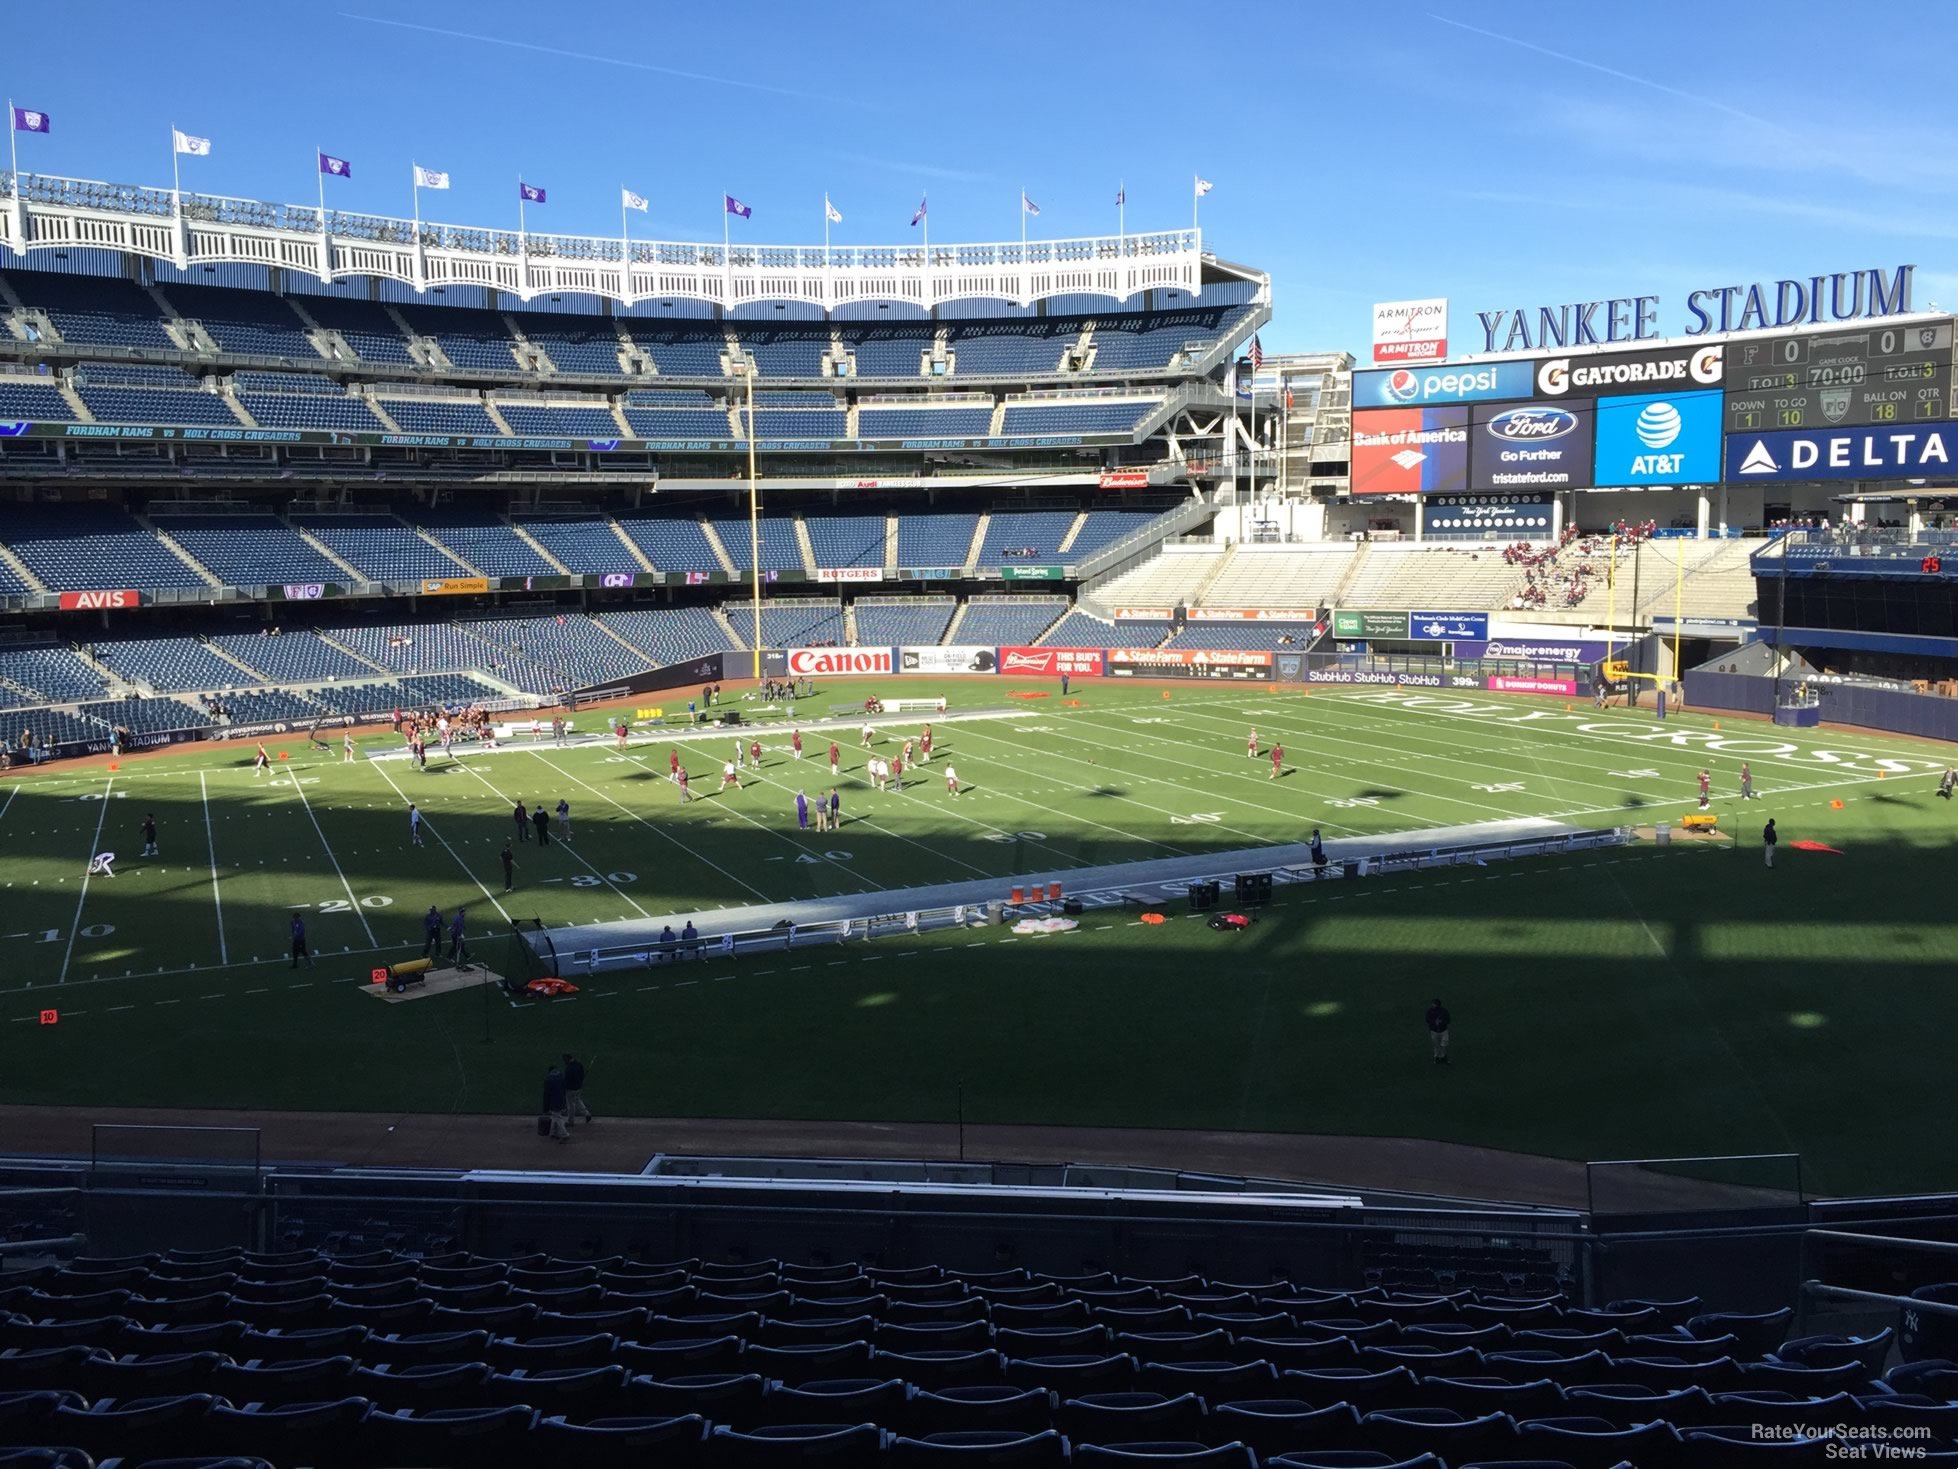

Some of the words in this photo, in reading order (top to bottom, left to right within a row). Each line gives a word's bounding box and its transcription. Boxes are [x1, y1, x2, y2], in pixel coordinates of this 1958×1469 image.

[1378, 305, 1443, 319] ARMITRON
[1475, 295, 1660, 353] YANKEE
[1685, 264, 1917, 337] STADIUM
[1379, 342, 1440, 355] ARMITRON
[1818, 358, 1836, 366] GAME
[1837, 356, 1860, 365] CLOCK
[1571, 360, 1688, 387] GATORADE
[1810, 365, 1865, 387] 70:00
[1424, 367, 1497, 398] pepsi
[1864, 392, 1888, 403] BALL
[1889, 391, 1907, 401] ON
[1918, 388, 1940, 398] QTR
[1731, 400, 1765, 411] DOWN
[1775, 399, 1790, 409] TO
[1790, 397, 1808, 408] GO
[1782, 410, 1800, 425] 10
[1876, 404, 1895, 420] 18
[1504, 411, 1558, 437] Ford
[66, 425, 121, 436] FORDHAM
[121, 427, 154, 438] RAMS
[183, 429, 209, 439] HOLY
[210, 430, 242, 440] CROSS
[244, 431, 302, 442] CRUSADERS
[1353, 431, 1391, 447] Bank
[1391, 429, 1408, 445] of
[1408, 427, 1467, 444] America
[381, 434, 424, 445] FORDHAM
[424, 436, 450, 446] RAMS
[472, 437, 494, 447] HOLY
[494, 438, 523, 448] CROSS
[523, 439, 572, 449] CRUSADERS
[645, 441, 686, 450] FORDHAM
[686, 442, 711, 450] RAMS
[755, 441, 782, 450] CROSS
[783, 441, 831, 450] CRUSADERS
[901, 440, 939, 449] FORDHAM
[940, 439, 965, 448] RAMS
[987, 438, 1008, 447] HOLY
[1008, 437, 1033, 447] CROSS
[1033, 436, 1083, 446] CRUSADERS
[1500, 452, 1518, 462] Go
[1519, 450, 1563, 461] Further
[1792, 433, 1949, 470] DELTA
[1631, 454, 1685, 475] AT&T
[1101, 475, 1147, 488] Budweiser
[1492, 471, 1569, 485] tristateford.com
[1922, 557, 1940, 572] 25
[822, 569, 878, 578] RUTGERS
[427, 582, 442, 591] SAP
[444, 583, 460, 591] Run
[461, 582, 484, 592] Simple
[76, 591, 125, 608] AVIS
[790, 651, 891, 674] Canon
[1055, 652, 1075, 662] THIS
[1076, 652, 1101, 662] BUD'S
[1056, 662, 1072, 672] FOR
[1073, 663, 1093, 673] YOU.
[1309, 671, 1351, 682] StubHub
[1354, 672, 1396, 684] StubHub
[1398, 674, 1440, 686] StubHub
[1341, 691, 1590, 722] HOLY
[1576, 723, 1944, 772] CROSS
[318, 895, 394, 913] 20
[373, 969, 386, 980] 20
[42, 1011, 55, 1023] 10
